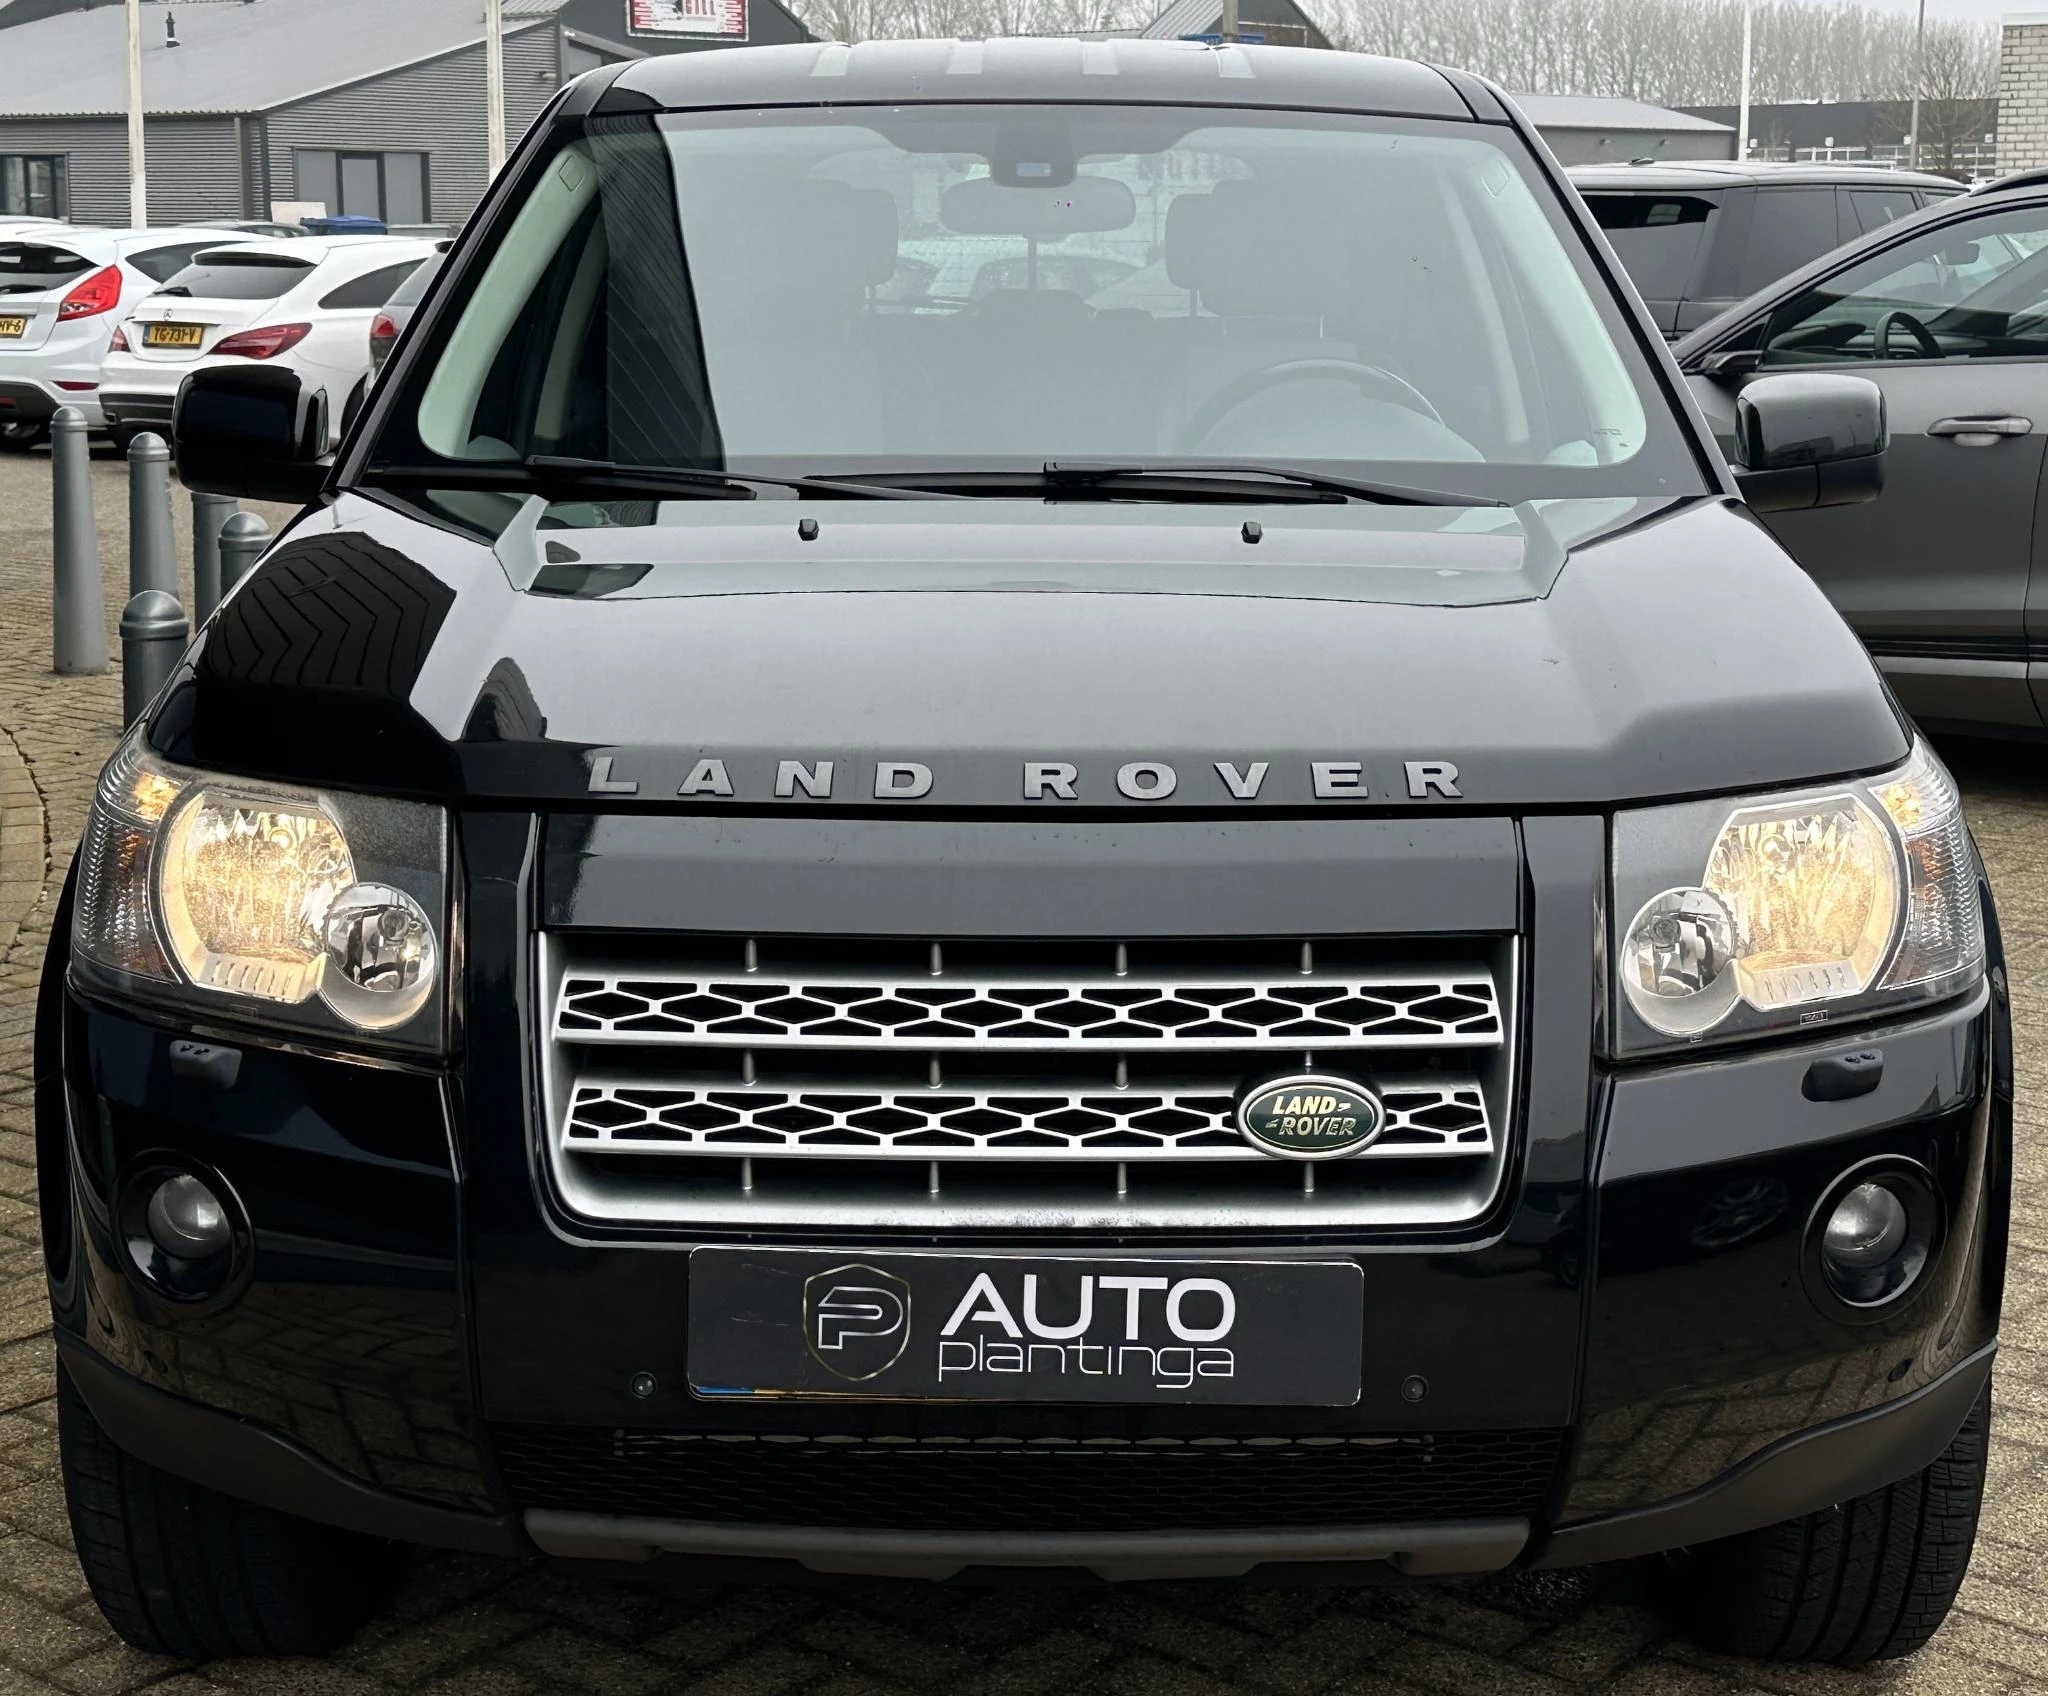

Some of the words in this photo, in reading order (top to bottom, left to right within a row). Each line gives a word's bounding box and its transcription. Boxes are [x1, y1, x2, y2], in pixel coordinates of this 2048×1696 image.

[588, 757, 934, 799] LAND
[1023, 761, 1463, 800] ROVER
[940, 1272, 1236, 1342] AUTO
[938, 1333, 1234, 1389] plantinga
